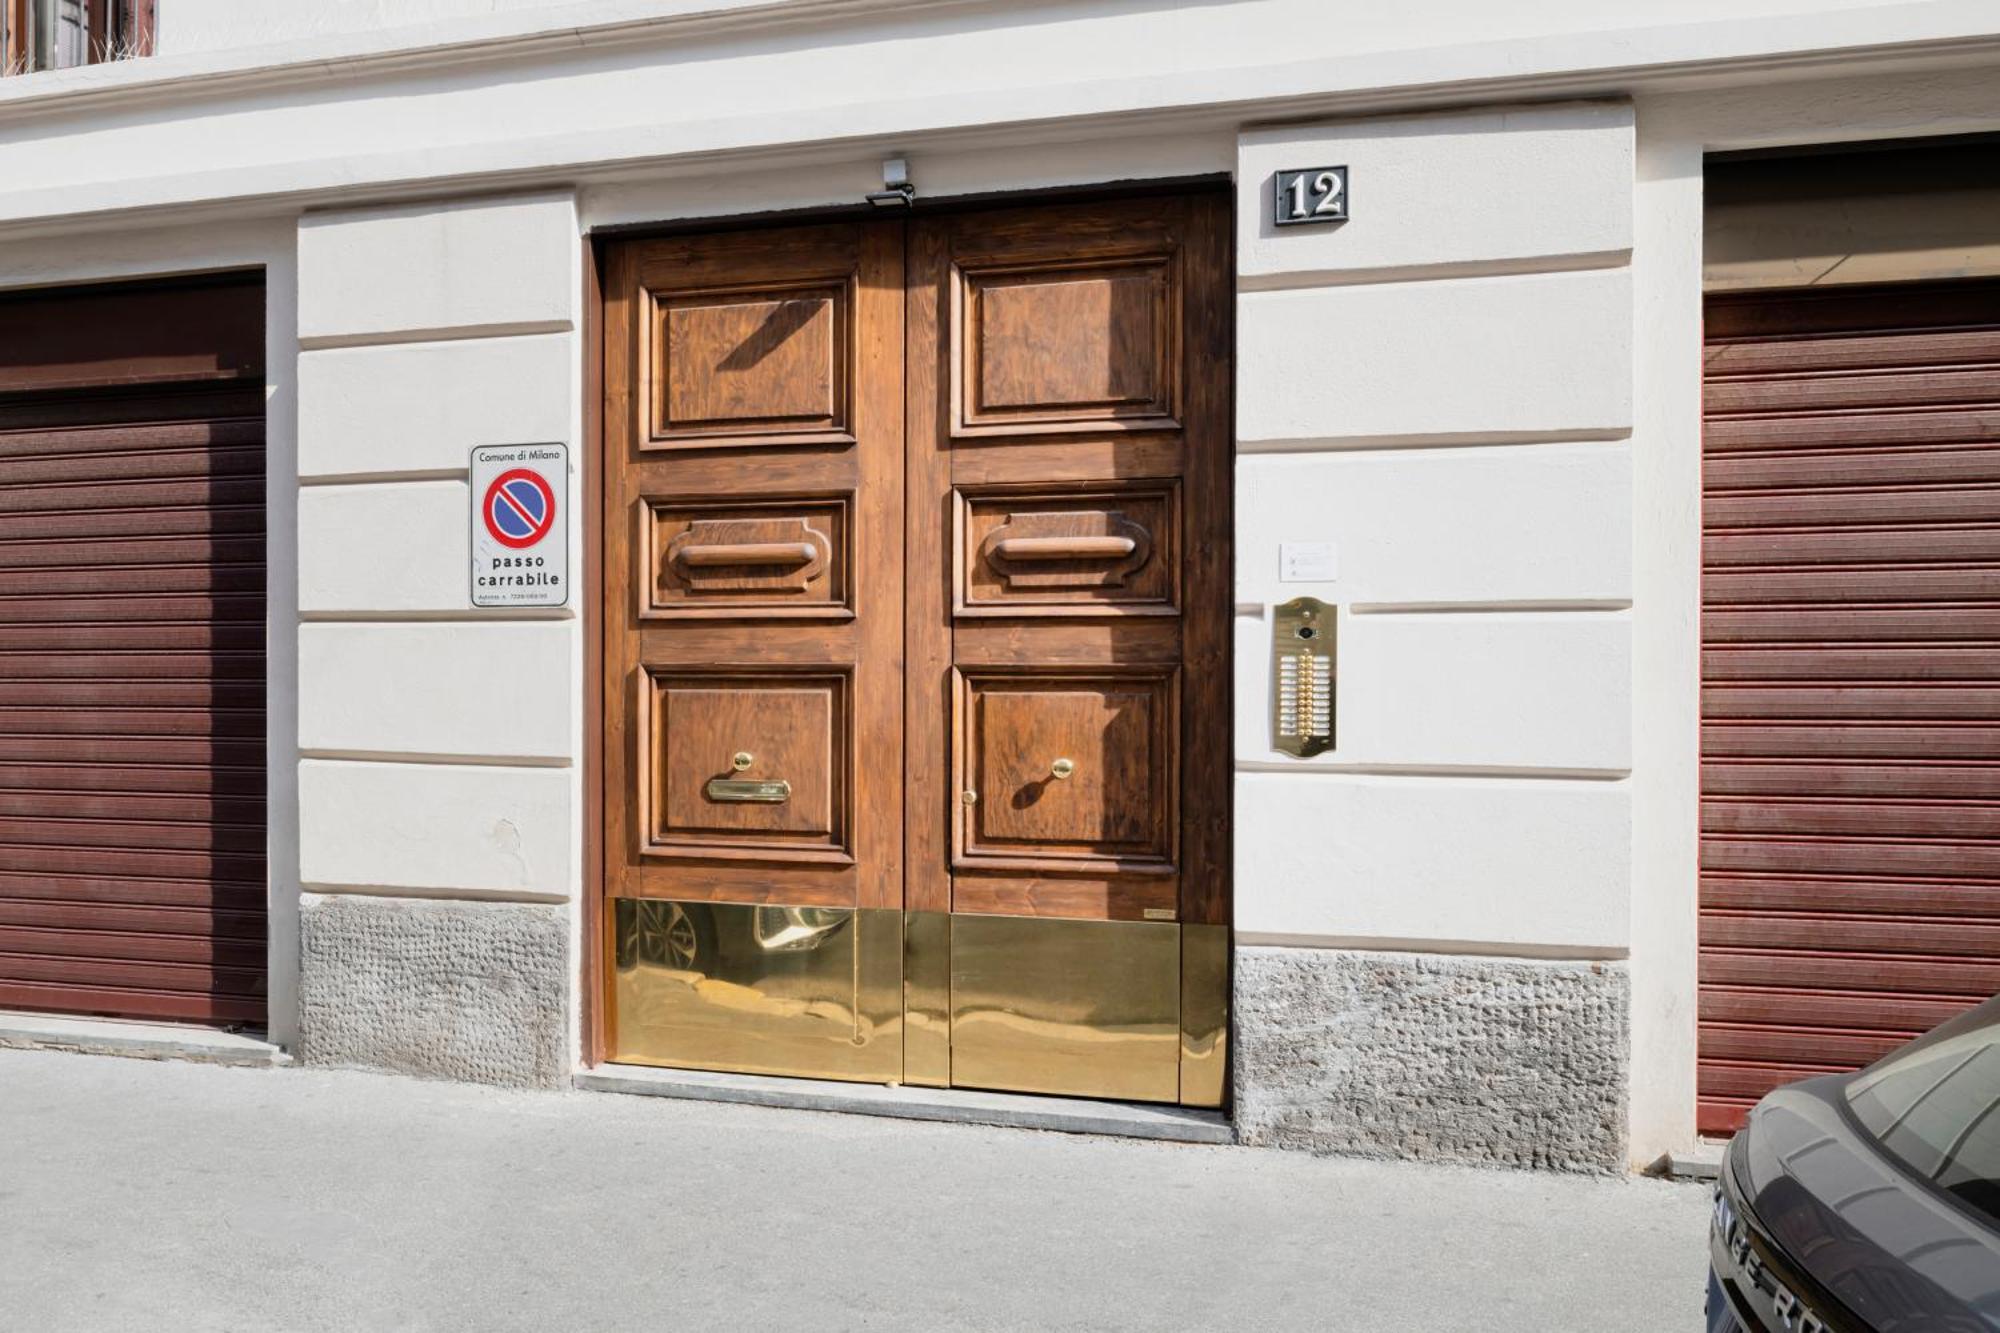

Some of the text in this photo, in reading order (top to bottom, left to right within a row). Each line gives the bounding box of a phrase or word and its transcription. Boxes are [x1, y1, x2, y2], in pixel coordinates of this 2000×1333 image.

[1291, 172, 1341, 216] 12
[479, 449, 560, 462] Comune di Milano
[493, 557, 544, 570] passo
[478, 572, 559, 586] carrabile
